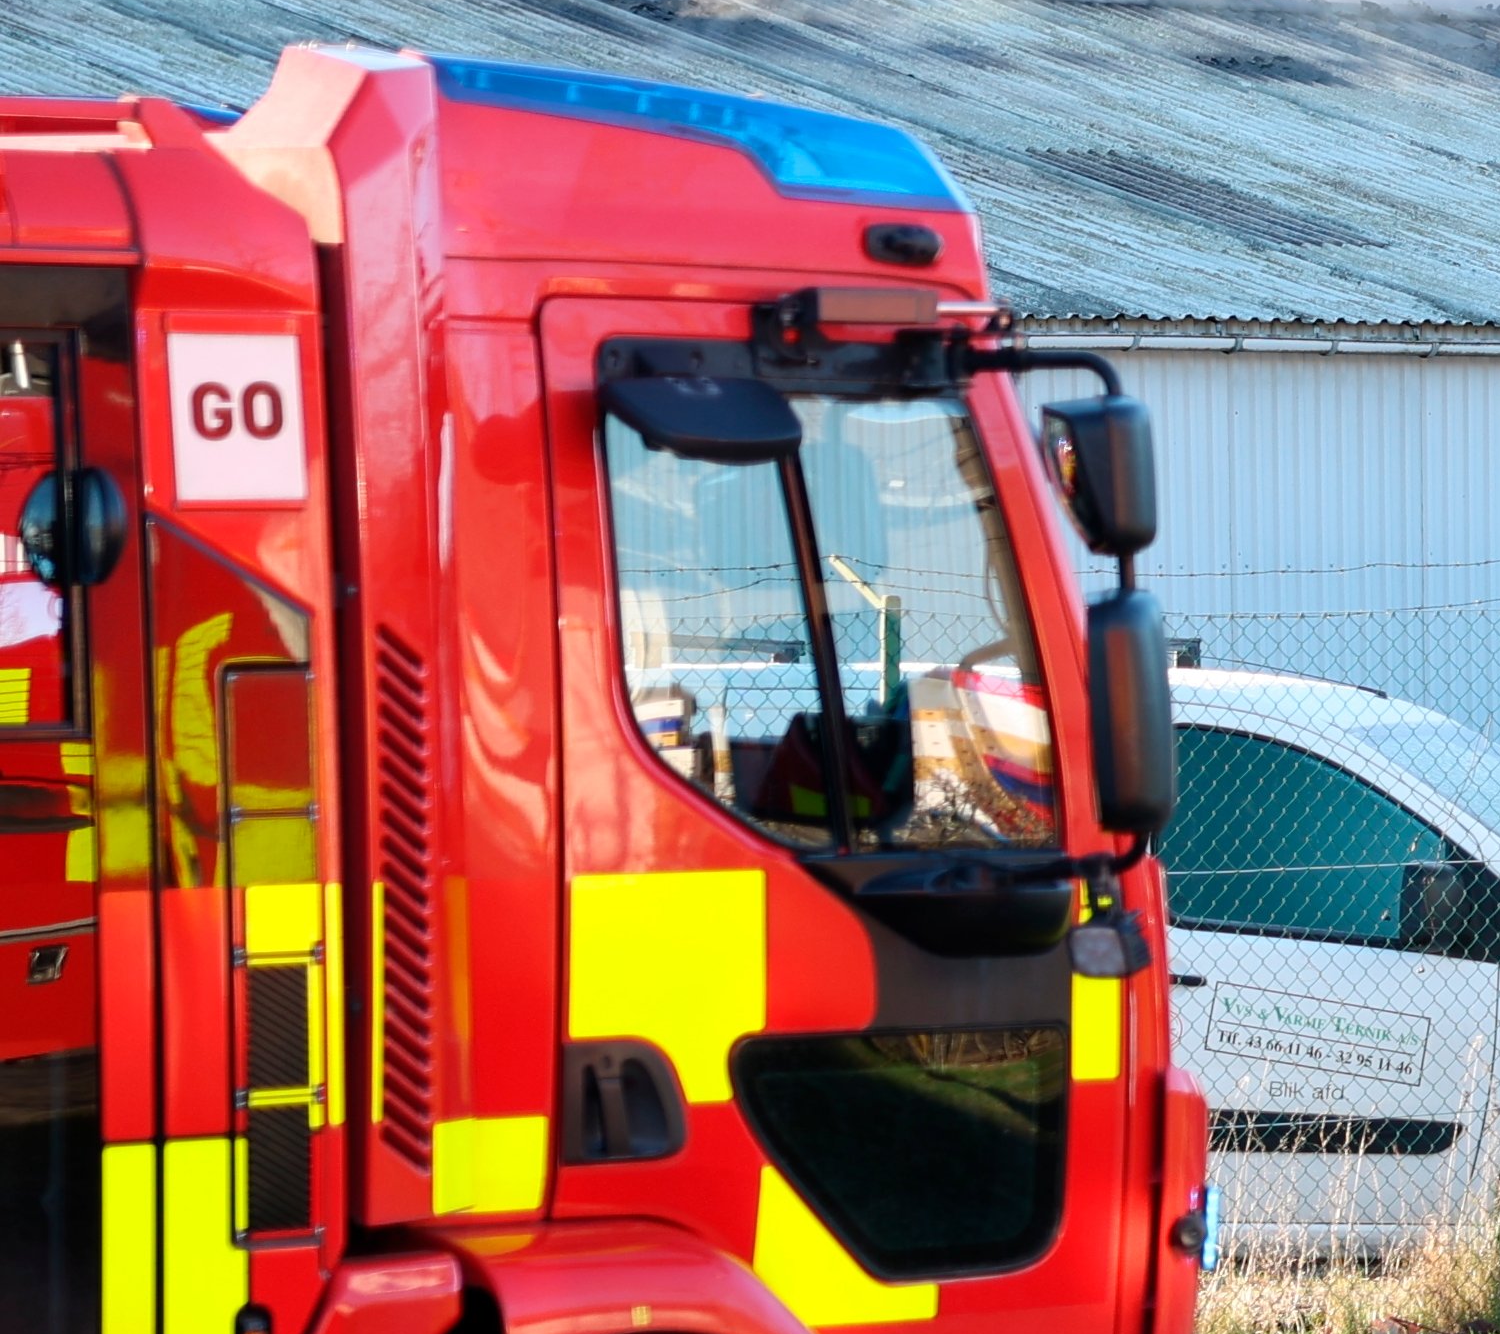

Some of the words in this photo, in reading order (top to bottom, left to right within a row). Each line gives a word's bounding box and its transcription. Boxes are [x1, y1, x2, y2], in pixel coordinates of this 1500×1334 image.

[191, 381, 284, 441] GO
[1257, 1008, 1270, 1022] &
[1245, 1033, 1262, 1048] 43
[1266, 1037, 1283, 1053] 66
[1306, 1045, 1323, 1060] 46
[1335, 1050, 1353, 1065] 32
[1357, 1054, 1373, 1068] 95
[1395, 1060, 1413, 1075] 46
[1269, 1080, 1304, 1099] Blik
[1312, 1085, 1350, 1101] afd.
